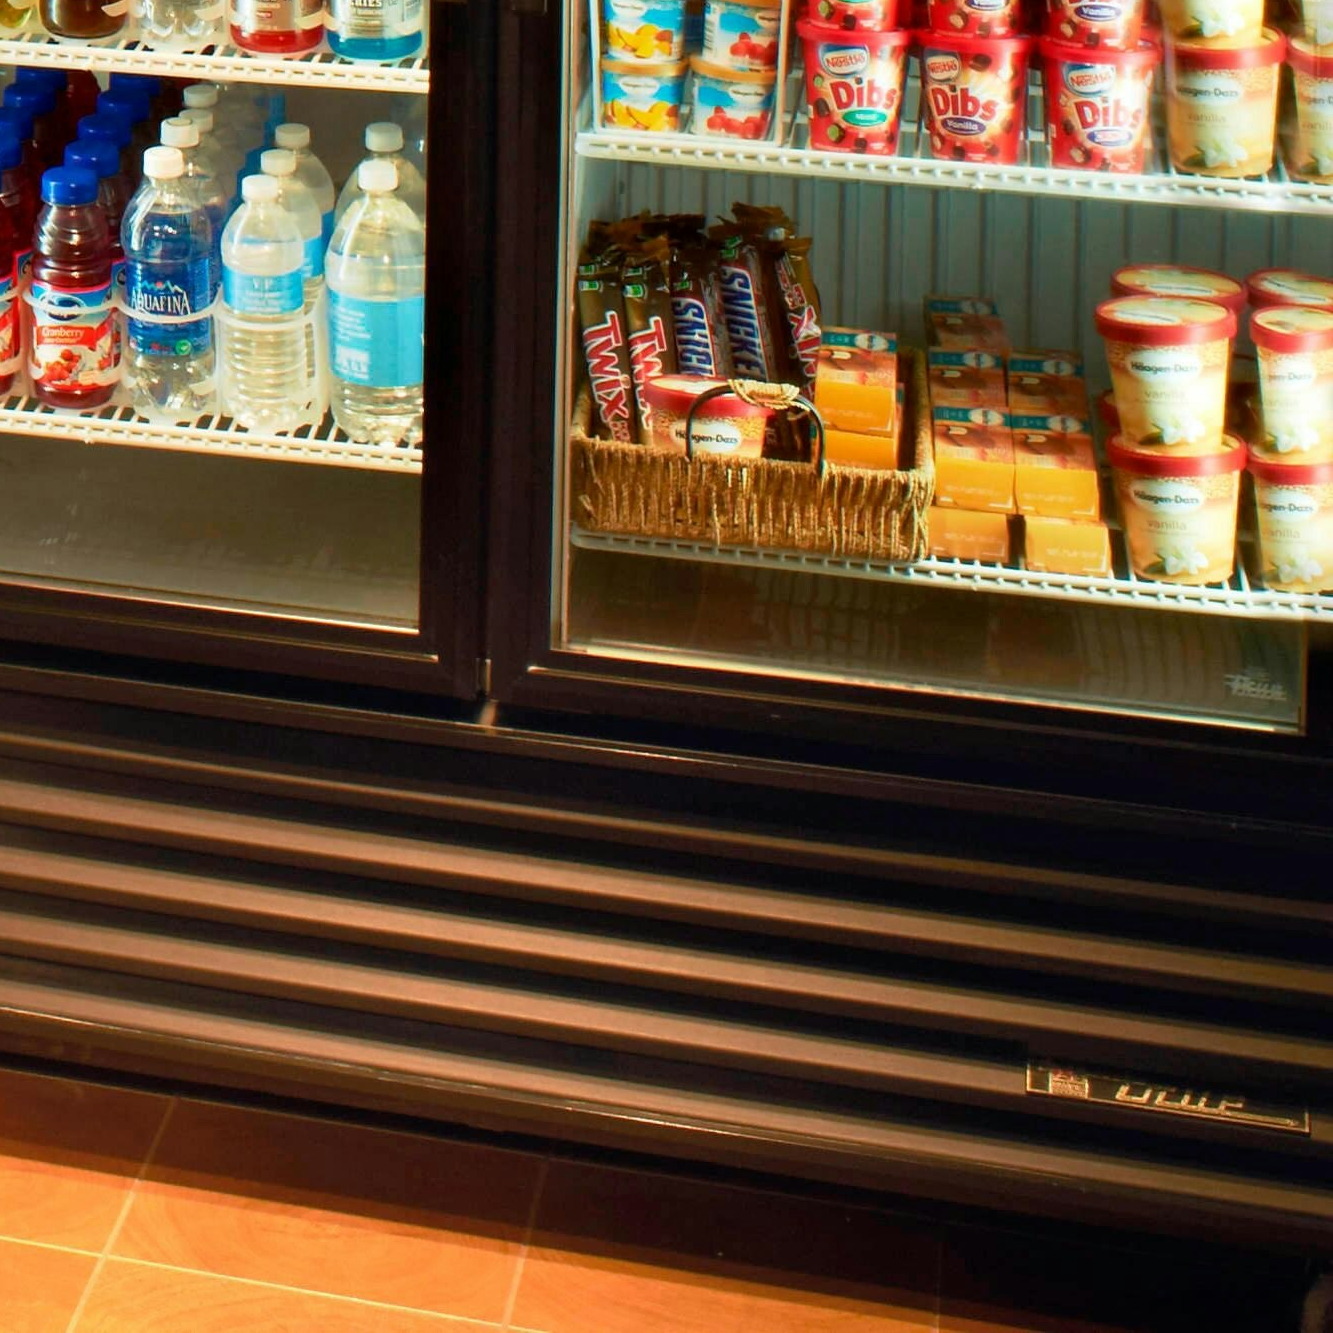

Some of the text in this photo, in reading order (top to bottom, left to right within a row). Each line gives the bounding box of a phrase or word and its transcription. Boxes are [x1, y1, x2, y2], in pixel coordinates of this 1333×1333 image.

[830, 78, 896, 110] Dibs
[931, 89, 999, 119] Dibs
[1075, 98, 1144, 128] Dibs
[132, 290, 191, 316] AQUAFINA
[584, 311, 631, 422] TWIX
[1146, 517, 1187, 532] vanilla
